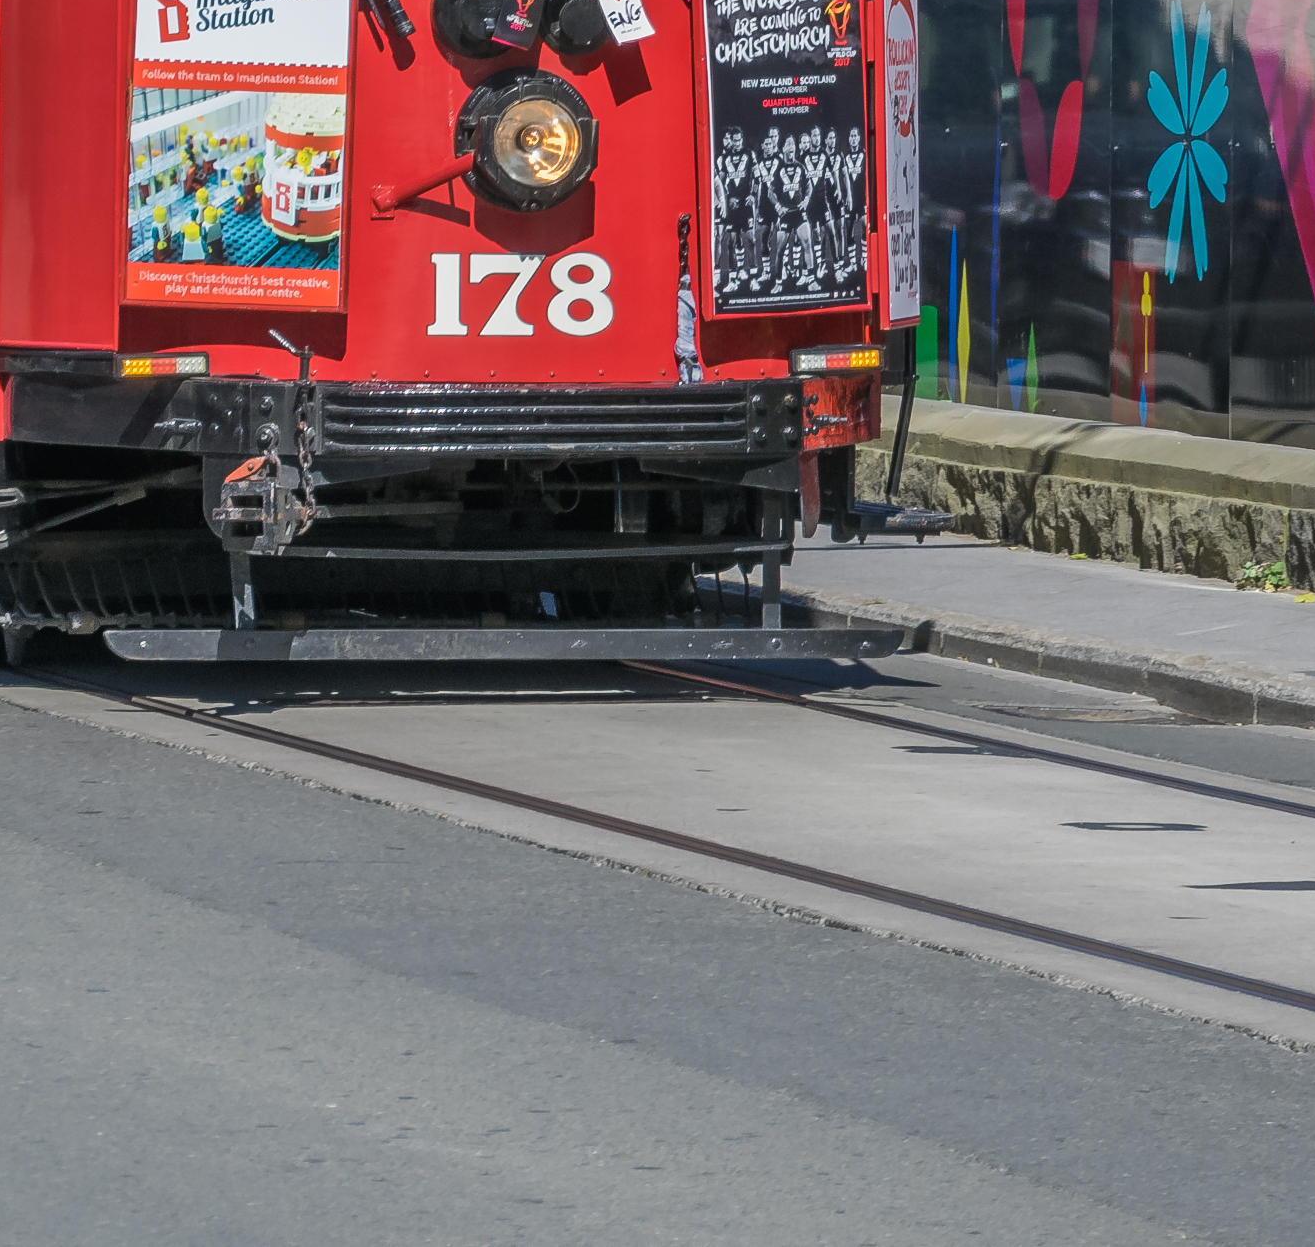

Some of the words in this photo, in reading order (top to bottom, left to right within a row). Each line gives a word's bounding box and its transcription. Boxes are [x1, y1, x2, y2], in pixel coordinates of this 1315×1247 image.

[196, 6, 275, 32] Station
[607, 0, 643, 29] ENG
[734, 16, 758, 36] ARE
[760, 6, 807, 30] COMING
[807, 7, 821, 22] TO
[715, 24, 830, 68] CHRISTCHURCH
[834, 57, 850, 67] 2017
[142, 69, 175, 80] Follow
[177, 69, 193, 80] the
[196, 71, 221, 82] tram
[223, 72, 234, 82] to
[236, 72, 296, 86] Imagination
[298, 74, 338, 86] Station!
[741, 79, 758, 89] NEW
[760, 77, 792, 87] ZEALAND
[799, 75, 836, 85] SCOTLAND
[777, 86, 807, 94] NOVEMBER
[762, 96, 818, 108] QUARTER-FINAL
[772, 107, 778, 115] 18
[778, 106, 809, 115] NOVEMBER
[139, 270, 183, 283] Discover
[185, 272, 258, 286] Christchurch's
[261, 275, 284, 287] best
[165, 282, 187, 296] play
[190, 283, 210, 295] and
[212, 285, 264, 297] education
[266, 288, 303, 299] centre.
[426, 252, 614, 337] 178
